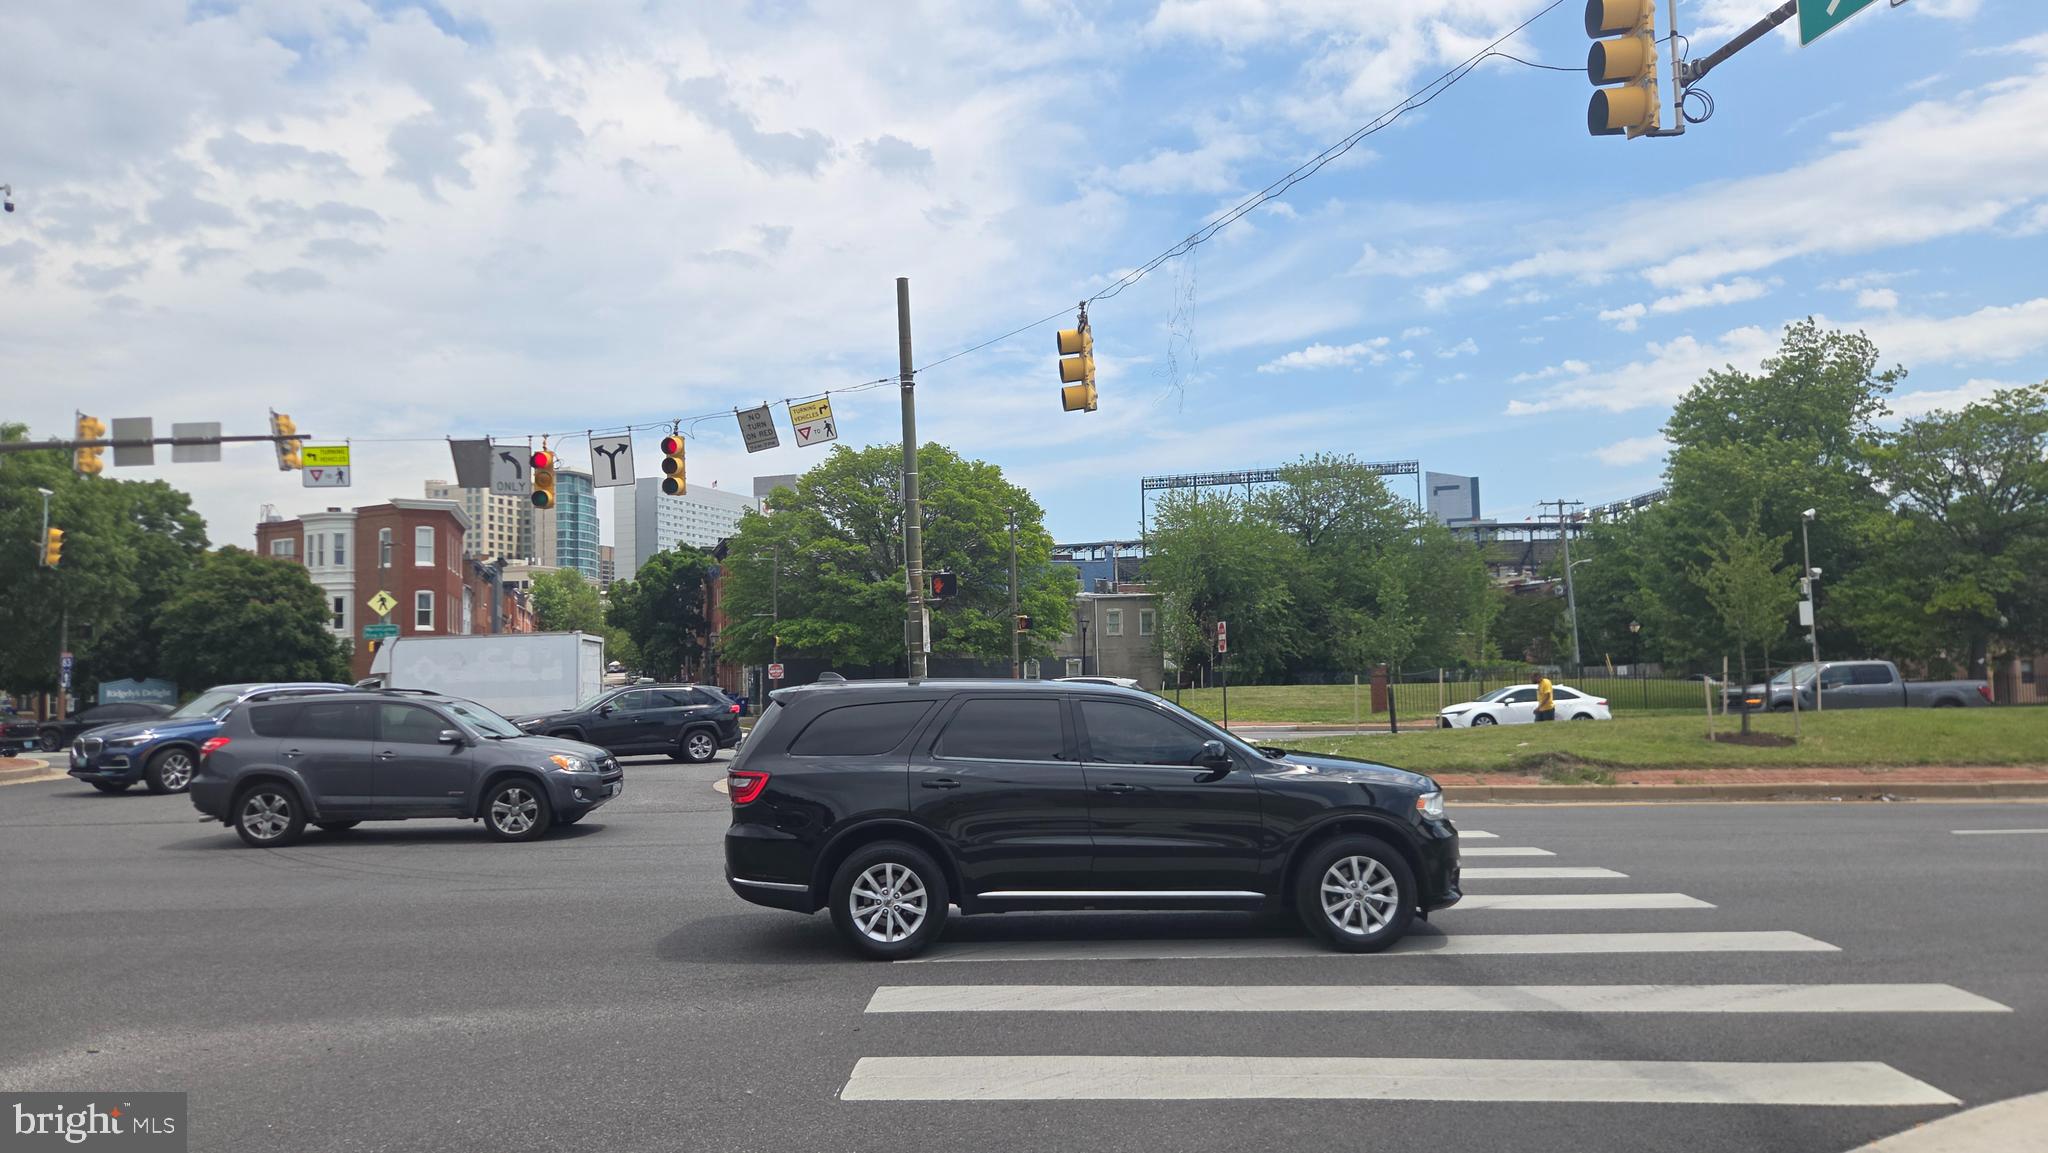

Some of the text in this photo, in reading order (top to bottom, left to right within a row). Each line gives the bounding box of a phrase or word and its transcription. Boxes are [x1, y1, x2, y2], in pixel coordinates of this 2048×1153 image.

[793, 405, 817, 414] TURNING
[748, 412, 760, 421] NO
[794, 412, 819, 423] VEHICLES
[747, 422, 767, 431] TURN
[746, 428, 774, 440] ON RED
[496, 481, 526, 492] ONLY
[142, 688, 172, 699] Delight
